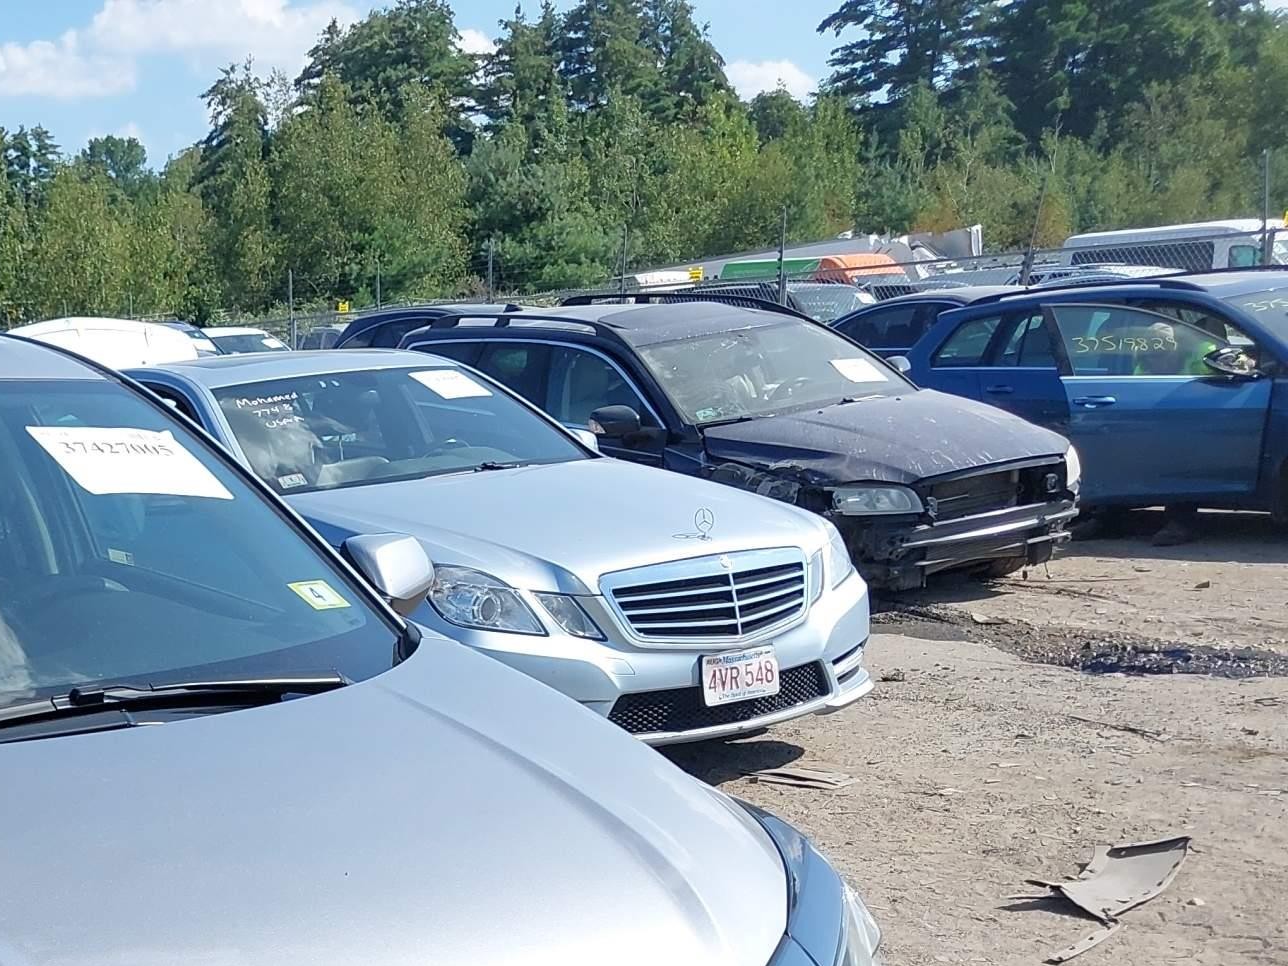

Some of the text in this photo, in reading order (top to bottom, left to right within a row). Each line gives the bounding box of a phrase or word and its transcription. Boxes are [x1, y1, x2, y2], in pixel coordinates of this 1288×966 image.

[1071, 335, 1178, 353] 37519829
[58, 441, 175, 457] 37427005
[708, 660, 775, 693] 4VR 548
